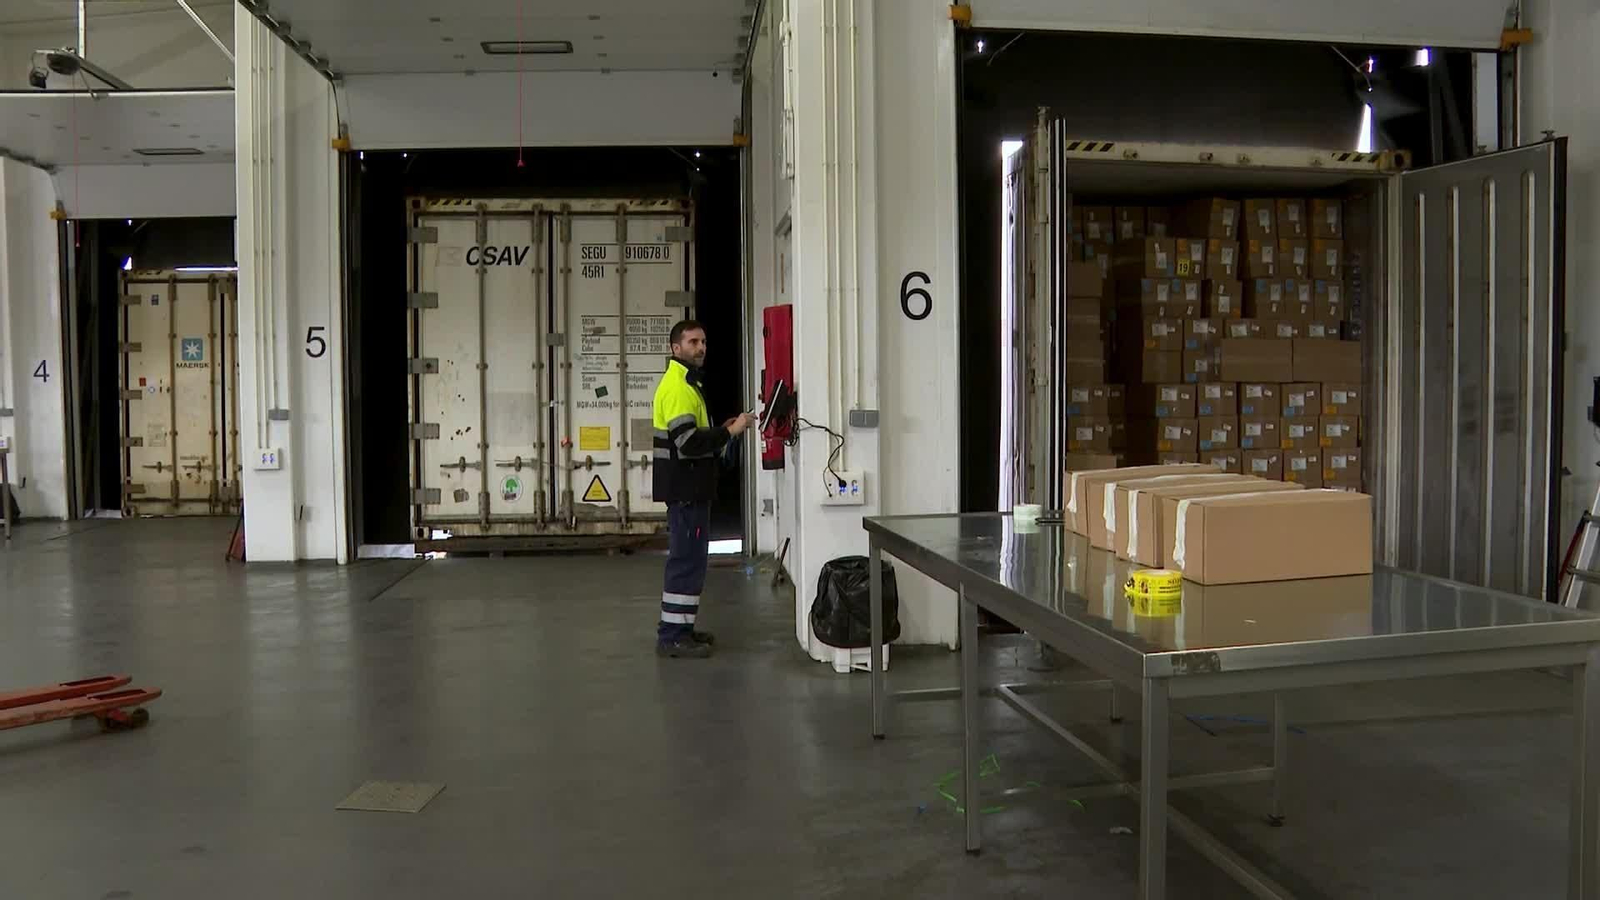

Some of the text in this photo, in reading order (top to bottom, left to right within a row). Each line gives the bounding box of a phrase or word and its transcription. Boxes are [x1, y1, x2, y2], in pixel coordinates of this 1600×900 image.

[465, 246, 530, 266] CSAV
[581, 246, 670, 260] SEGU 910678 0
[581, 265, 604, 278] 45R1
[1179, 263, 1188, 273] 19
[900, 271, 933, 320] 6
[305, 326, 326, 358] 5
[33, 359, 50, 383] 4
